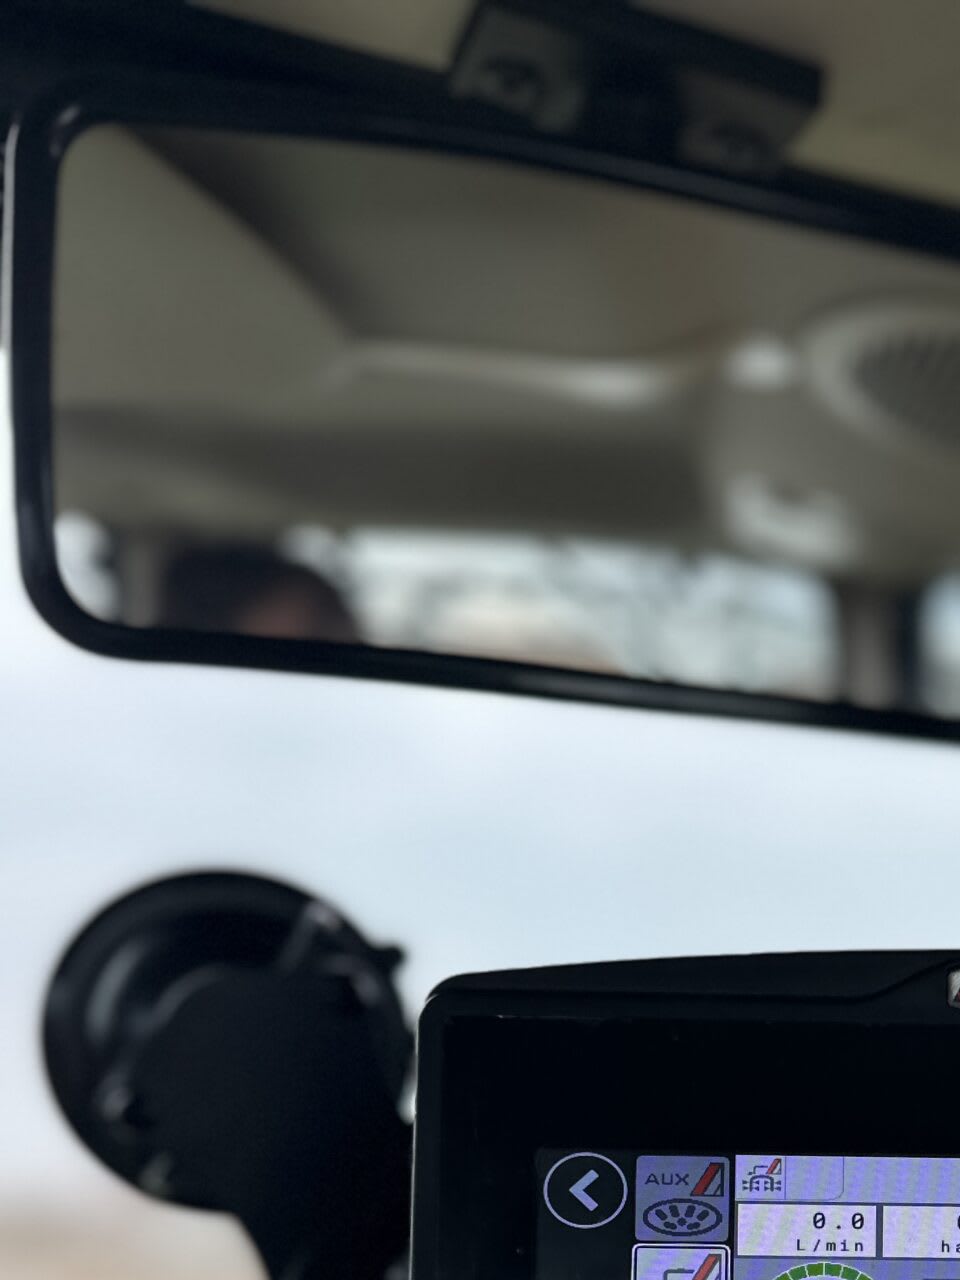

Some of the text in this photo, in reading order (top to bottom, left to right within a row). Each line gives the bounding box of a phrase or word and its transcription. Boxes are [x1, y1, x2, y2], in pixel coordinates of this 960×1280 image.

[645, 1173, 690, 1186] AUX
[812, 1212, 865, 1230] 0.0
[796, 1239, 864, 1252] L/min
